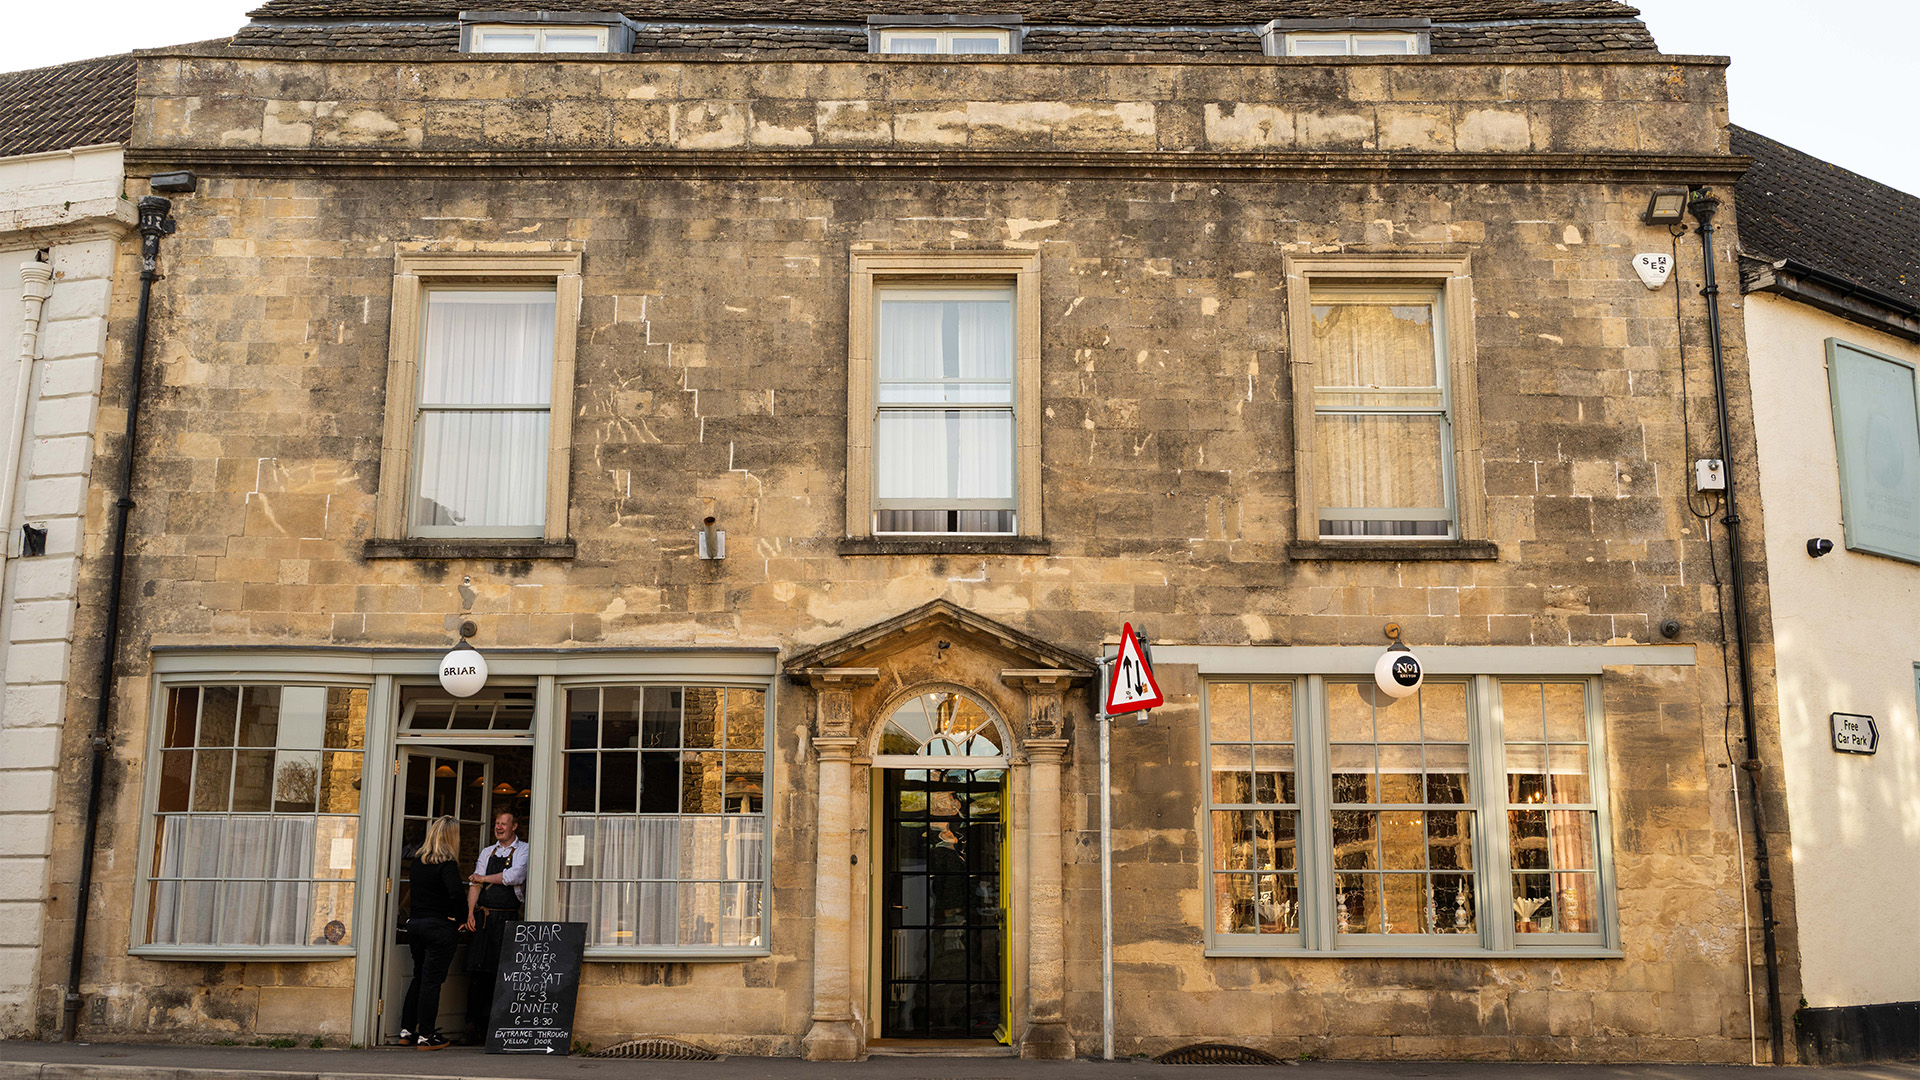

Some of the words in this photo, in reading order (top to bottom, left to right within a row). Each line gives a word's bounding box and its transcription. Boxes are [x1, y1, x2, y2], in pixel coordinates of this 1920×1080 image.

[443, 666, 477, 677] BRIAR
[1843, 719, 1859, 732] Free
[1837, 732, 1850, 744] Car
[1851, 734, 1868, 746] Park
[514, 923, 562, 943] BRIAR
[520, 942, 550, 953] TUES
[515, 952, 557, 964] DINNER
[512, 982, 548, 993] LUNCH
[509, 1002, 559, 1014] DINNER
[494, 1030, 533, 1039] ENTRANCE
[536, 1030, 569, 1039] THROUGH
[502, 1038, 530, 1047] YELLOW
[533, 1038, 553, 1046] DOOR
